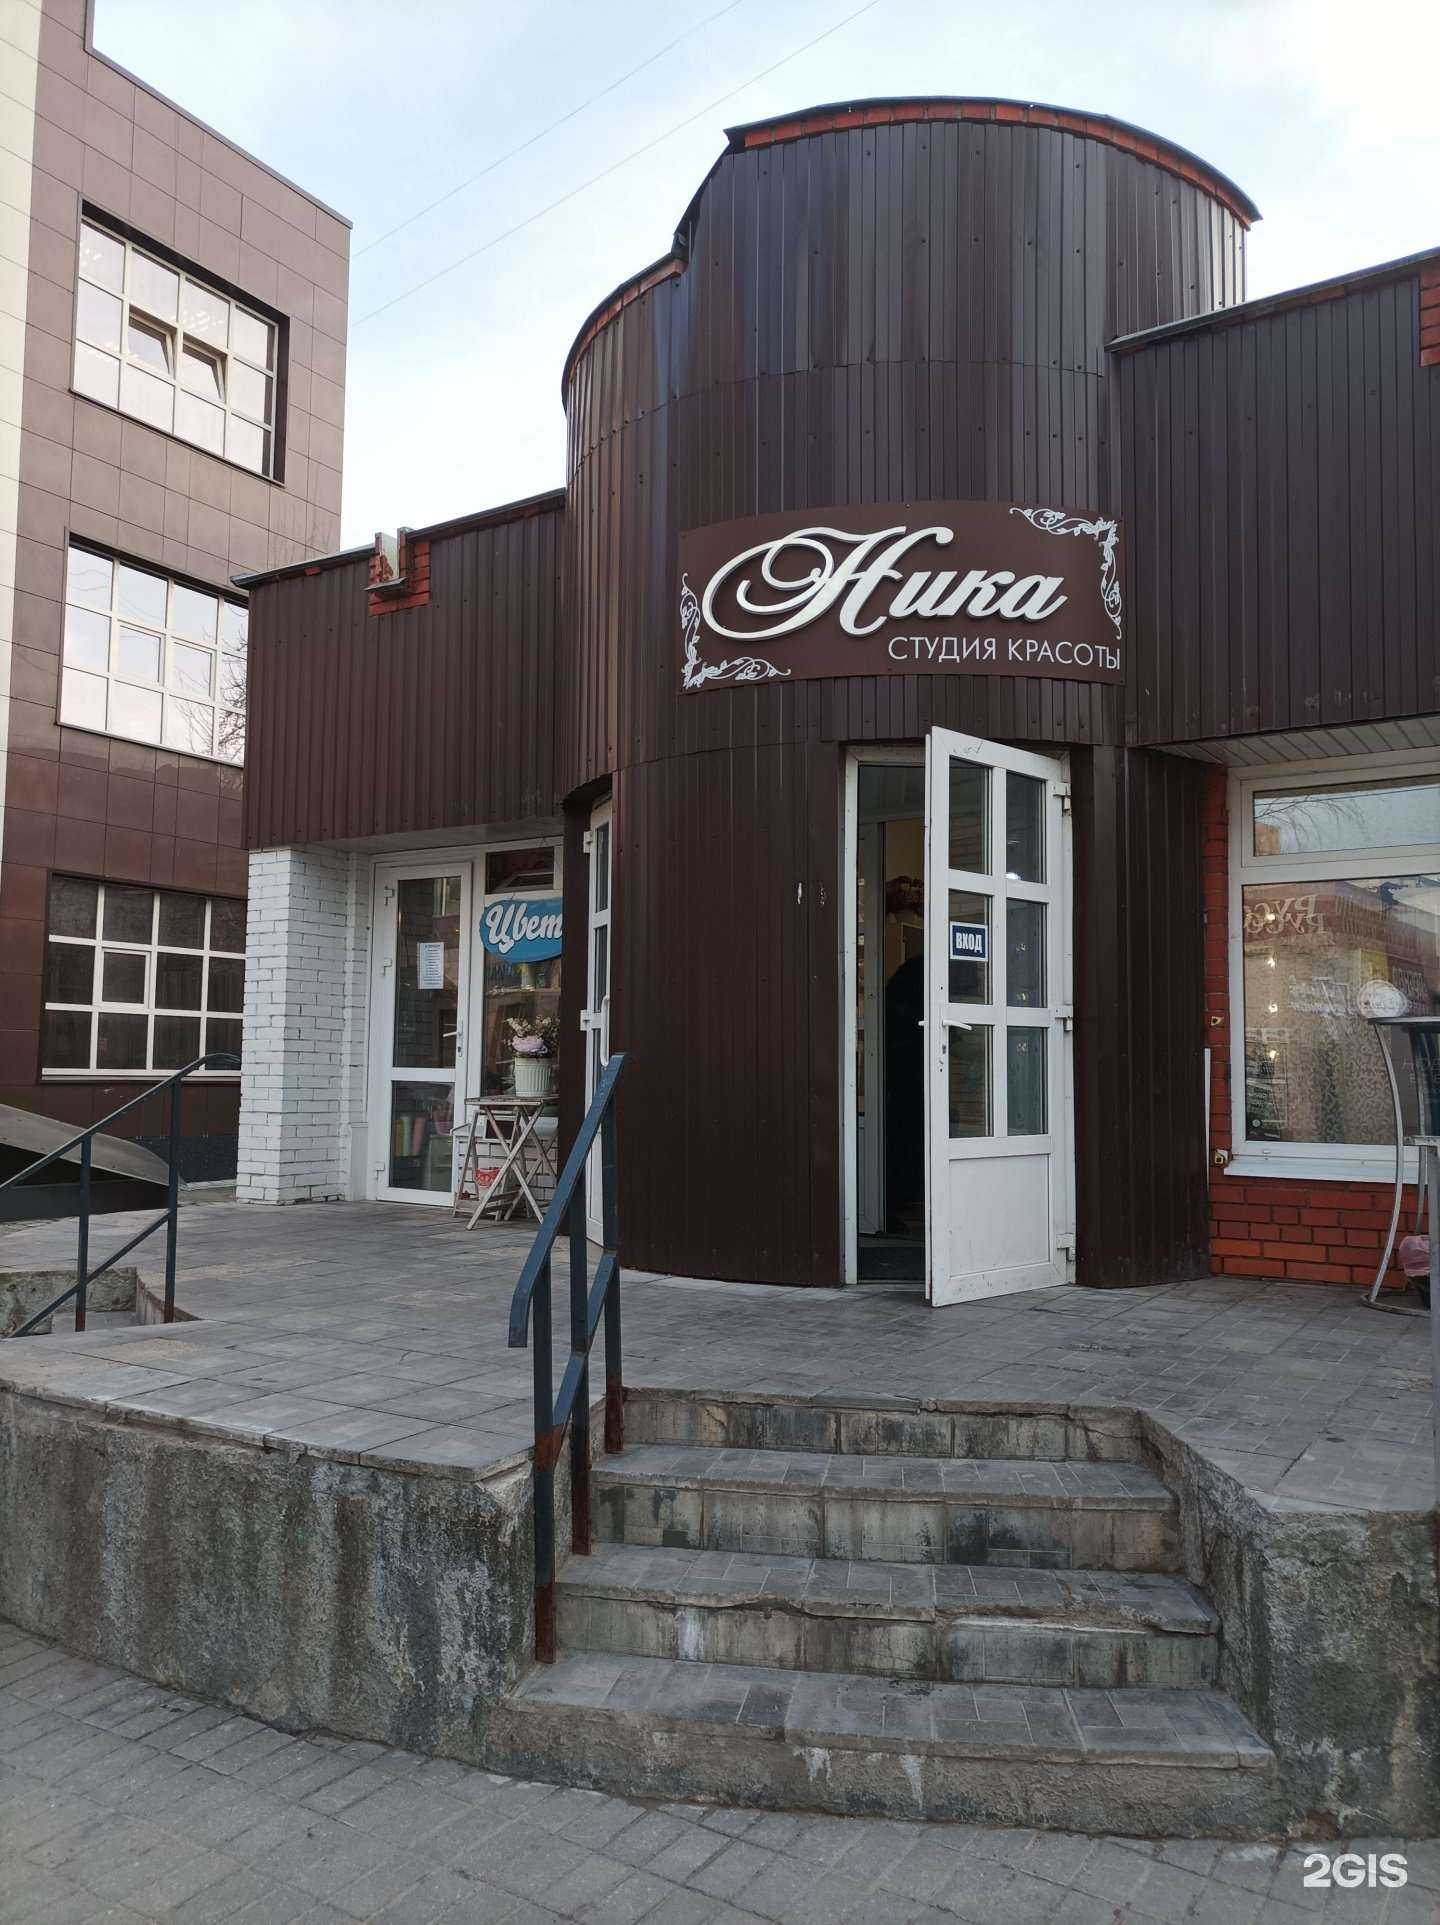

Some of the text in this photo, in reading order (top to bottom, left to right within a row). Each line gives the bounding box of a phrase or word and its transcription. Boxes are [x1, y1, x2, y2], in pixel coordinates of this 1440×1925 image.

[702, 526, 1069, 640] Ника
[888, 636, 1121, 670] СТУДИЯ КРАСОТЫ
[955, 932, 983, 953] ВХОД
